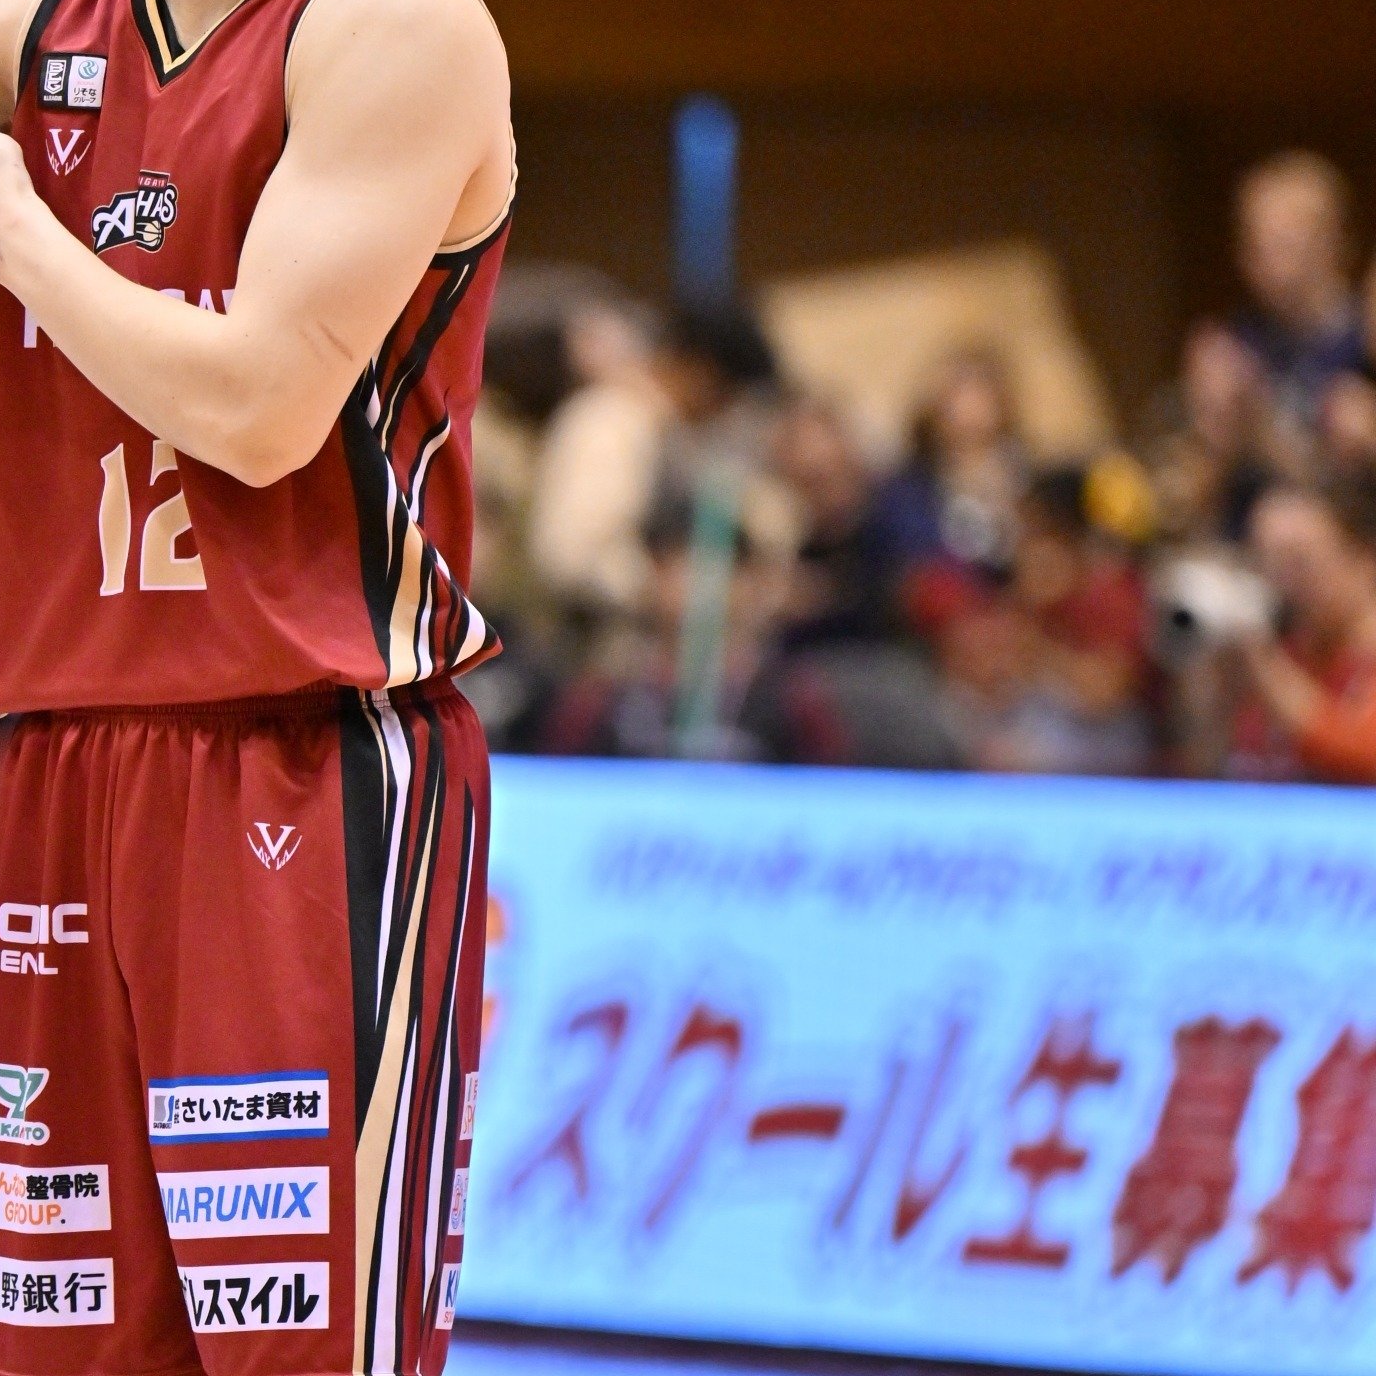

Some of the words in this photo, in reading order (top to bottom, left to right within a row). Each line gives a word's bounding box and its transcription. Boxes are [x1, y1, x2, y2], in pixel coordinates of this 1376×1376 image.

[99, 439, 208, 597] 12
[182, 1090, 321, 1123] さいたま資材
[161, 1181, 318, 1223] MARUNIX
[181, 1272, 320, 1327] レスマイル
